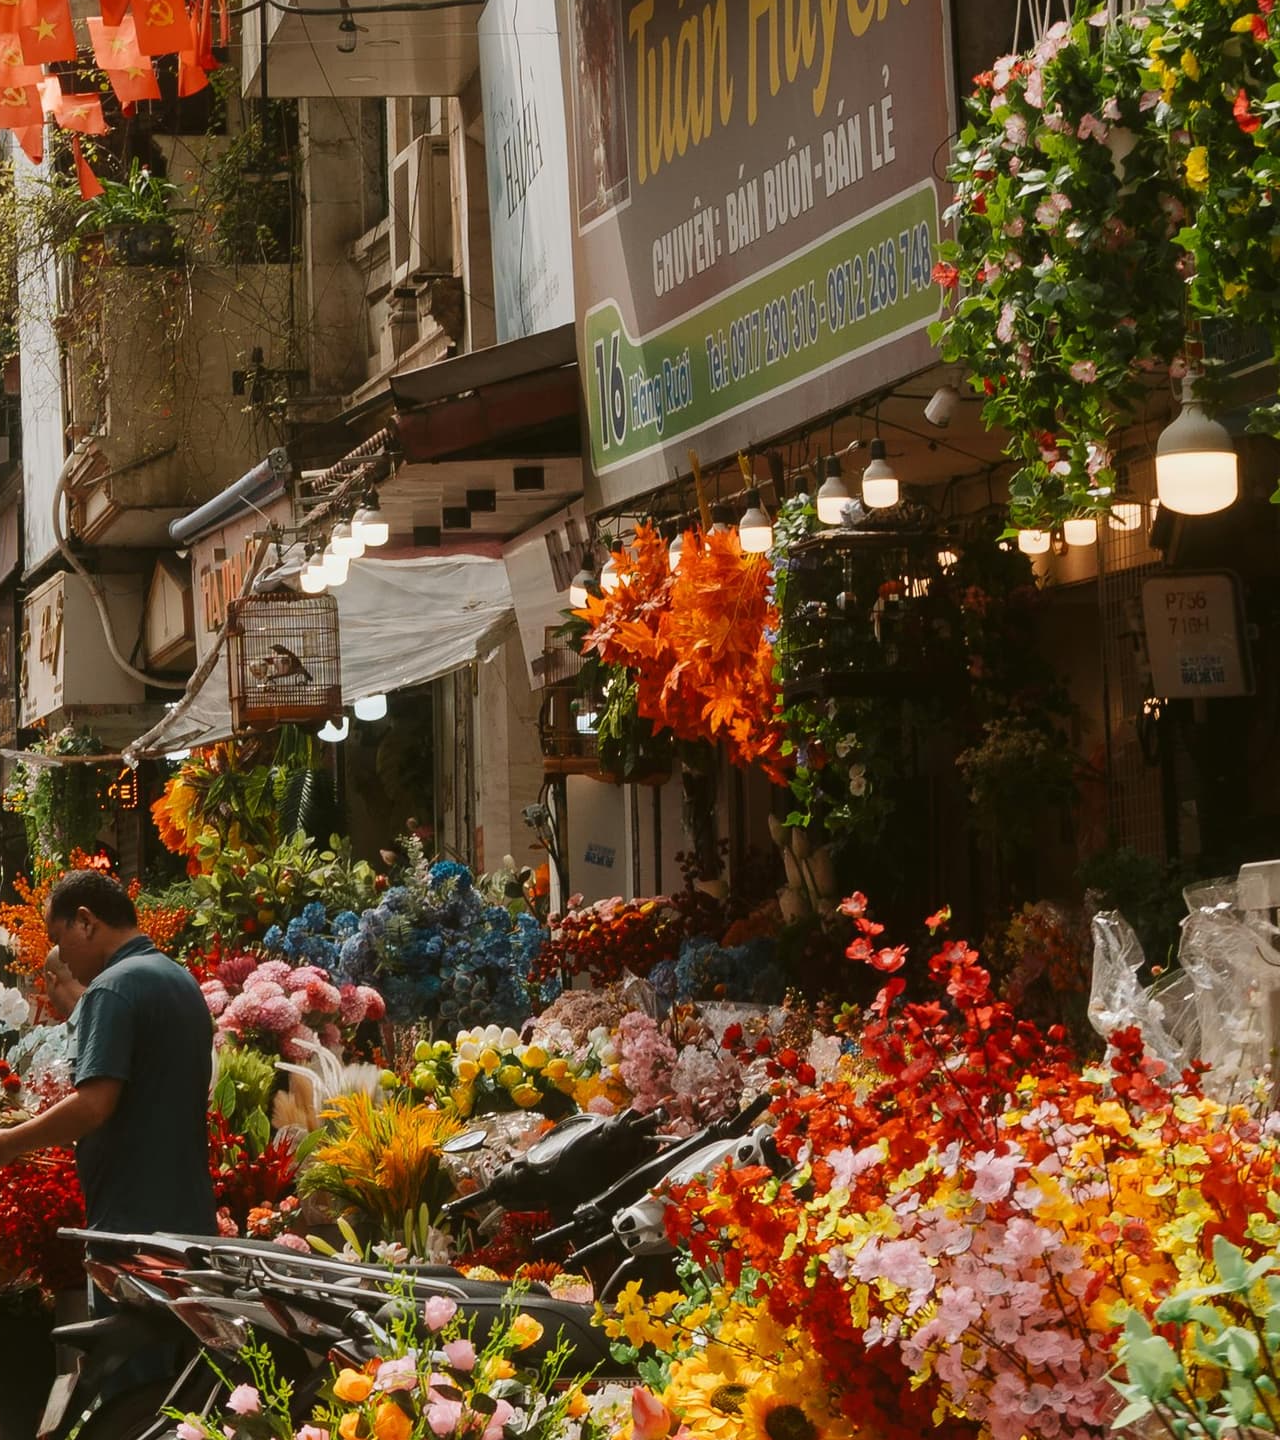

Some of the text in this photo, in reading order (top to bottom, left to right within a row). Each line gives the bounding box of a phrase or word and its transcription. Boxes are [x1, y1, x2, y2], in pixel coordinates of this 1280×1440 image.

[652, 196, 722, 298] CHUYÊN:
[726, 164, 761, 255] BÁN
[868, 64, 896, 172] LẺ
[593, 328, 628, 452] 16
[628, 365, 665, 437] Hàng
[705, 333, 730, 394] Tel:
[729, 309, 761, 383] 0917
[763, 295, 790, 367] 290
[790, 279, 818, 353] 316
[825, 254, 866, 334] 0912
[866, 237, 897, 314] 268
[899, 219, 933, 299] 748
